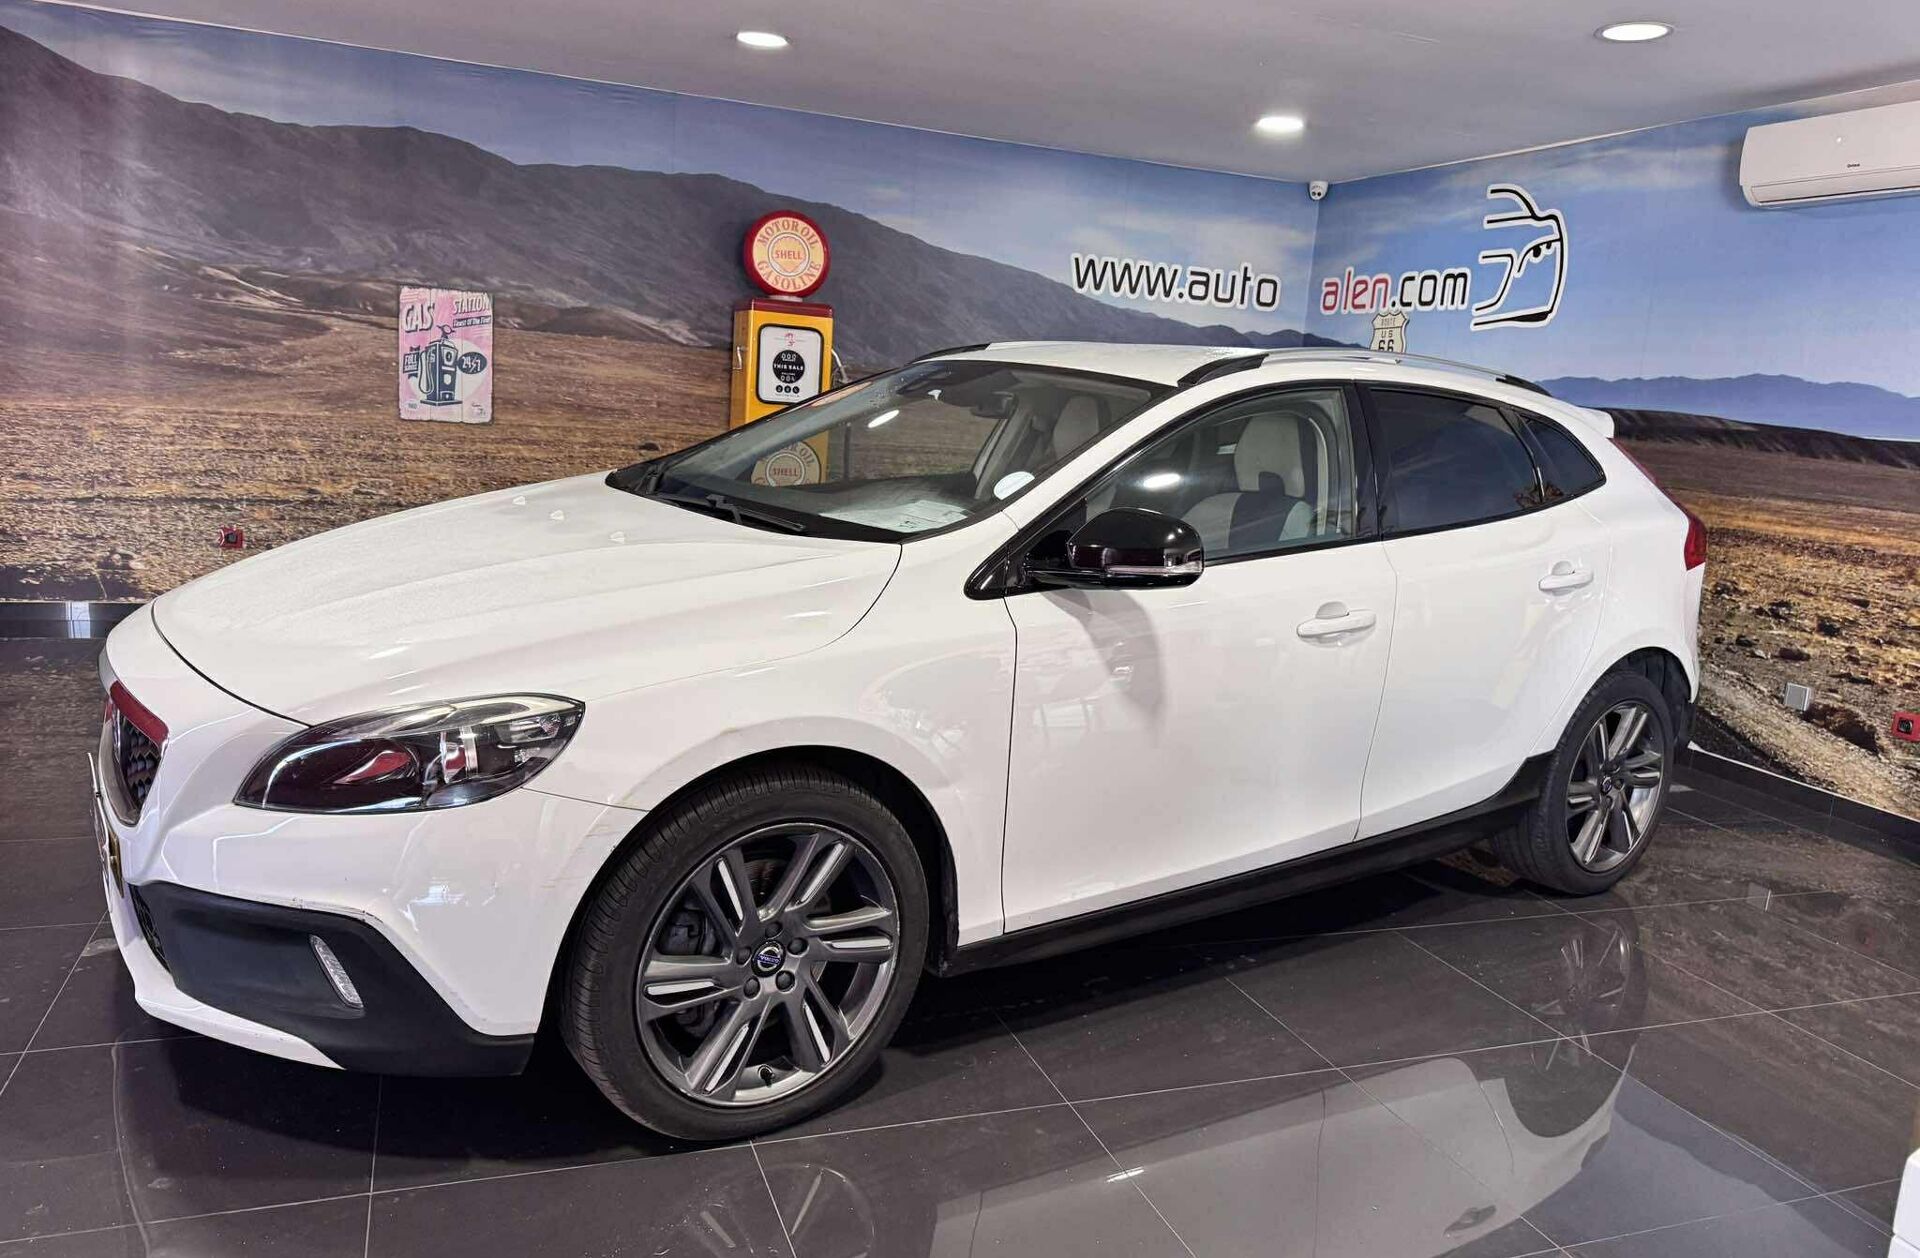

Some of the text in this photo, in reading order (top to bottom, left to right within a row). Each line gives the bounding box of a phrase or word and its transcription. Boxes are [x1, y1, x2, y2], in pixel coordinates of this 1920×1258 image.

[757, 219, 820, 249] MOTOR OIL
[774, 249, 803, 260] SHELL
[757, 260, 821, 290] GASOLINE
[1073, 256, 1469, 312] www.auto alen.com
[453, 294, 490, 315] STATION
[404, 302, 435, 333] GAS
[1378, 339, 1395, 352] 66
[462, 356, 481, 373] 24/7
[772, 467, 799, 477] SHELL
